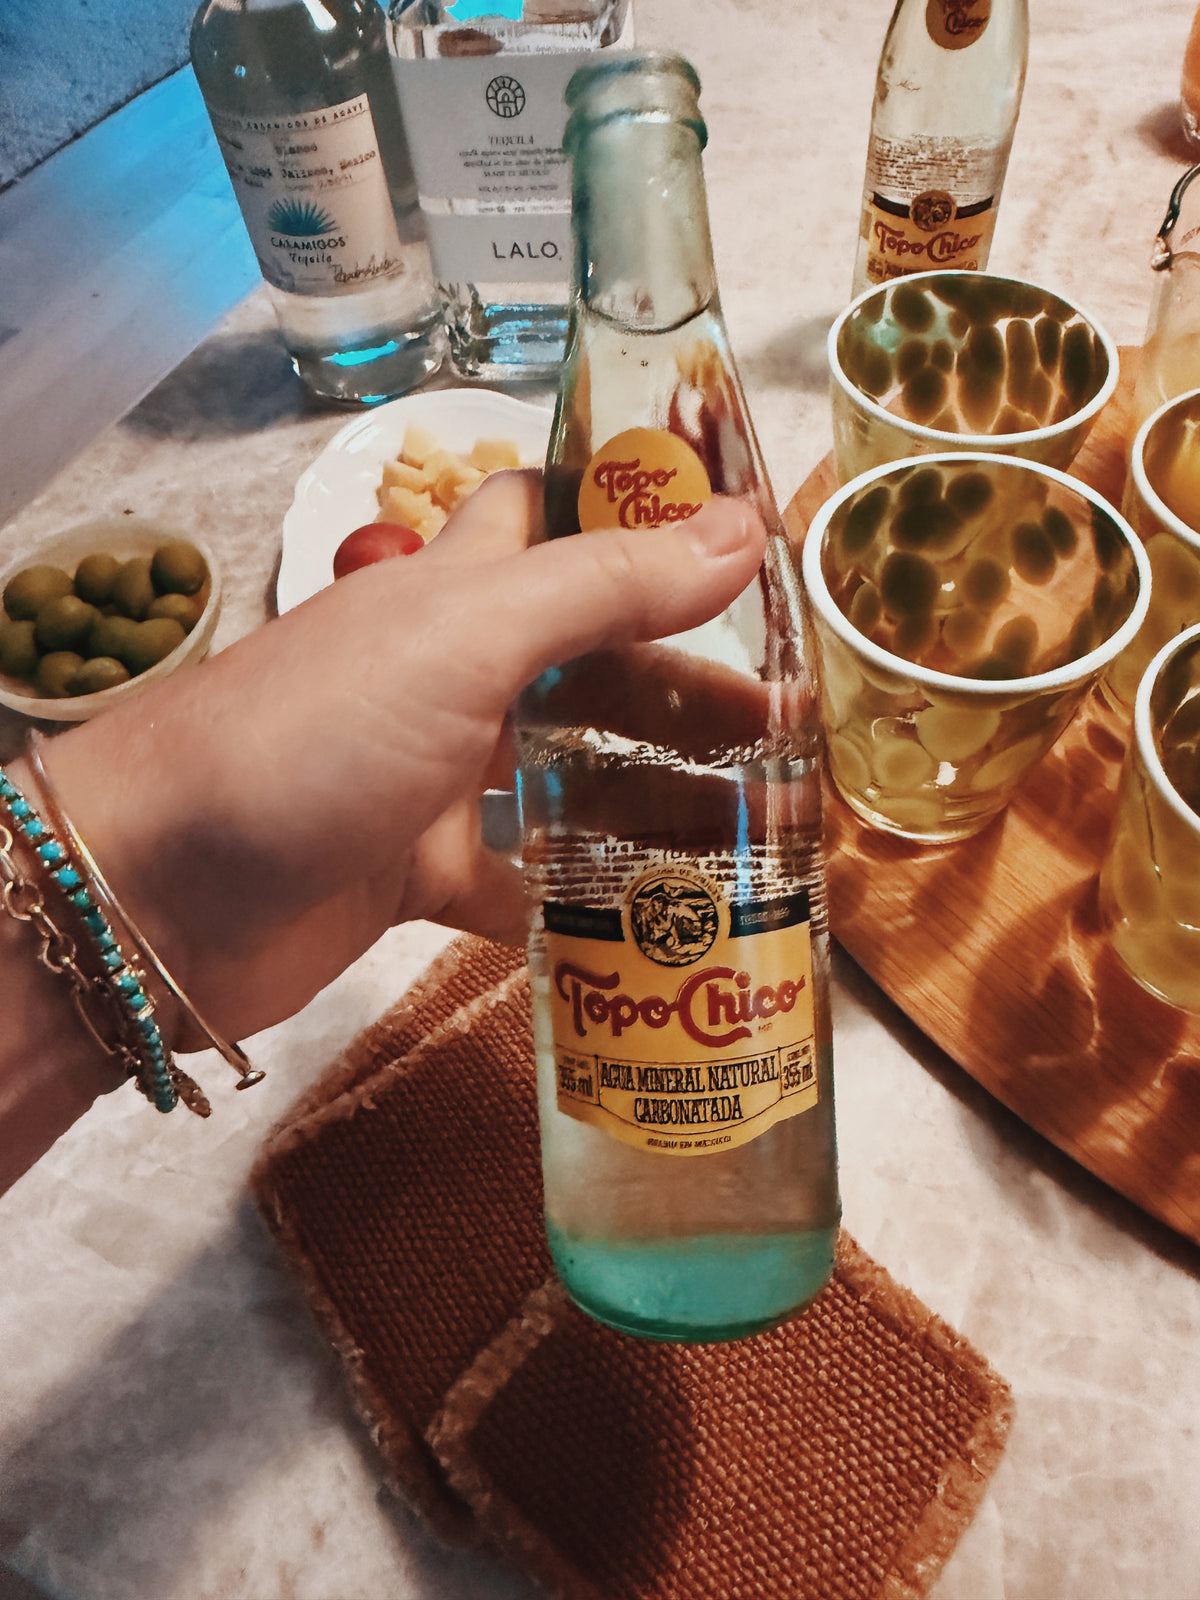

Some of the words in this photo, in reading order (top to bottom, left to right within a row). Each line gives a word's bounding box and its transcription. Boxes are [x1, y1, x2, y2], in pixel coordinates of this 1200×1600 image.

[488, 135, 535, 146] TEQUILA
[288, 252, 333, 267] Tequila
[874, 220, 926, 256] Topo
[926, 230, 983, 263] Chico
[593, 458, 678, 503] Topo
[617, 492, 704, 530] Chico
[555, 960, 678, 1037] Topo
[677, 965, 806, 1048] Chico
[600, 1062, 636, 1091] AGUA
[637, 1065, 706, 1094] MINERAL
[706, 1055, 779, 1092] NATURAL
[634, 1094, 745, 1125] CARBONATADA
